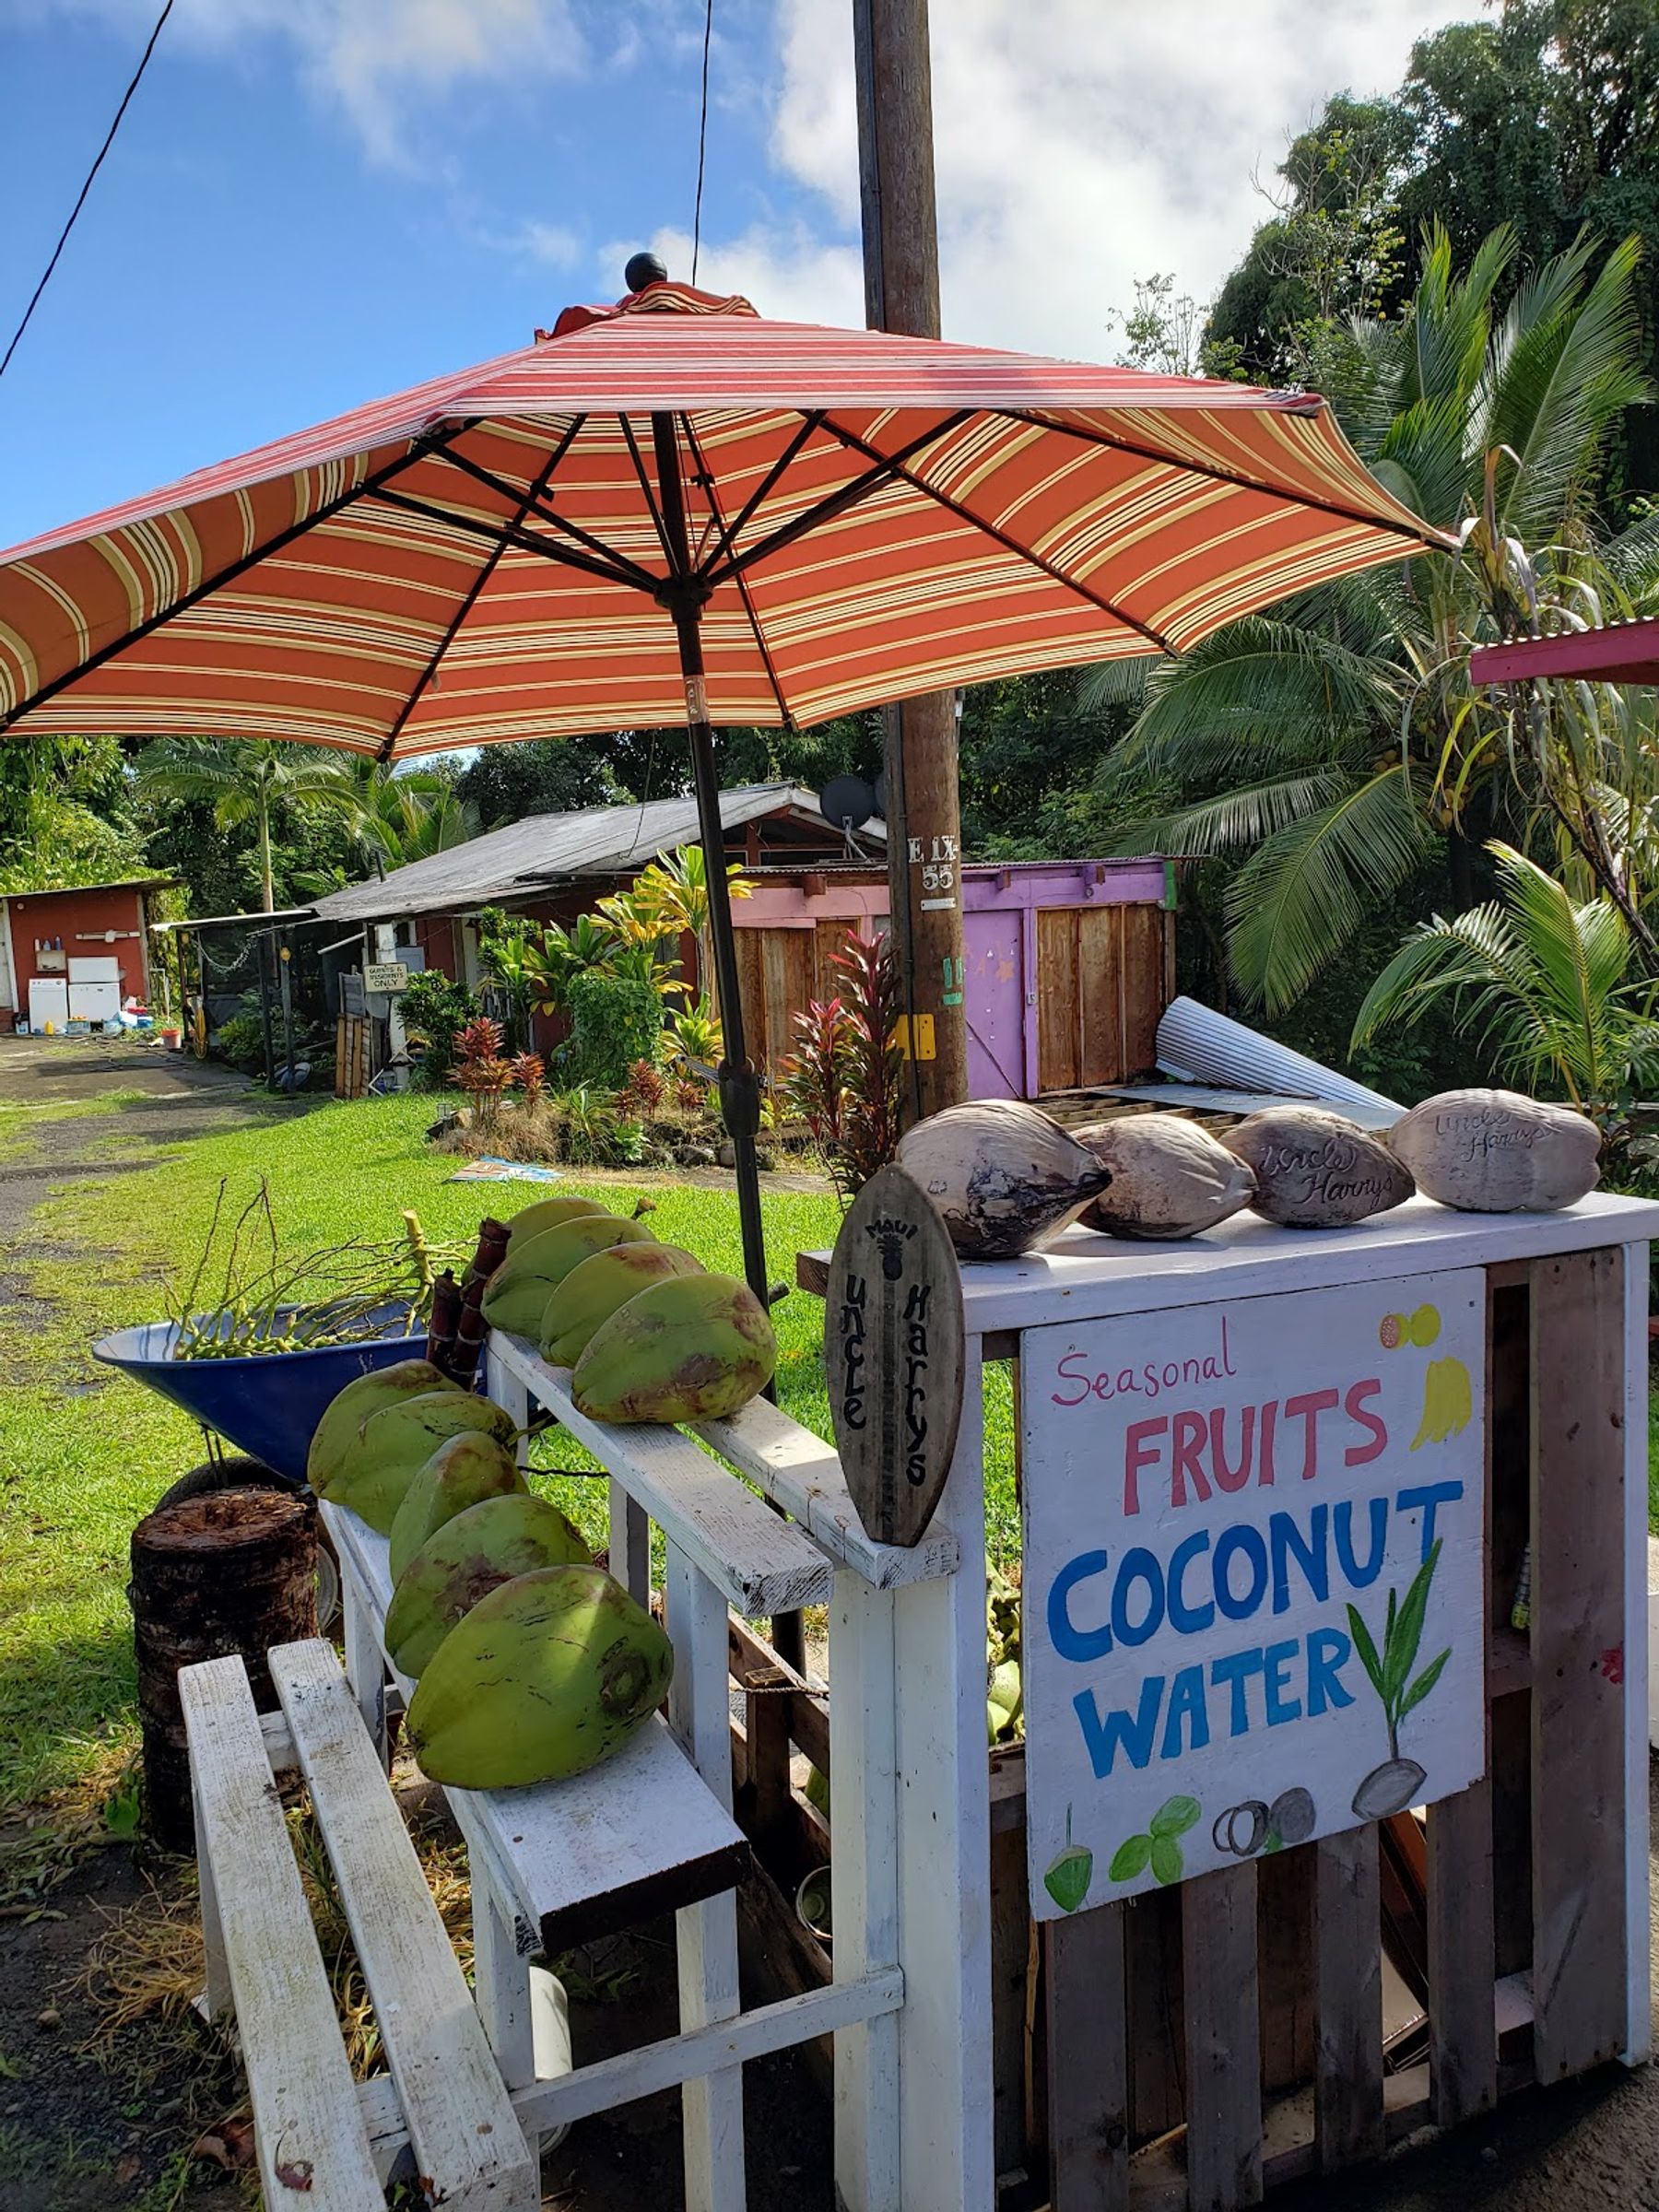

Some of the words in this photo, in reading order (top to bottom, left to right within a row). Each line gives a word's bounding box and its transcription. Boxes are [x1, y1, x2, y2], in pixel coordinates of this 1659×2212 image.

[907, 837, 924, 863] E
[922, 864, 954, 890] 55
[373, 979, 398, 987] ONLY
[1436, 1105, 1512, 1135] Uncle
[1259, 1136, 1357, 1178] Uncle
[1052, 1316, 1238, 1406] Seasonal
[1124, 1379, 1389, 1516] FRUITS
[1047, 1480, 1465, 1663] COCONUT
[1073, 1628, 1357, 1780] WATER
